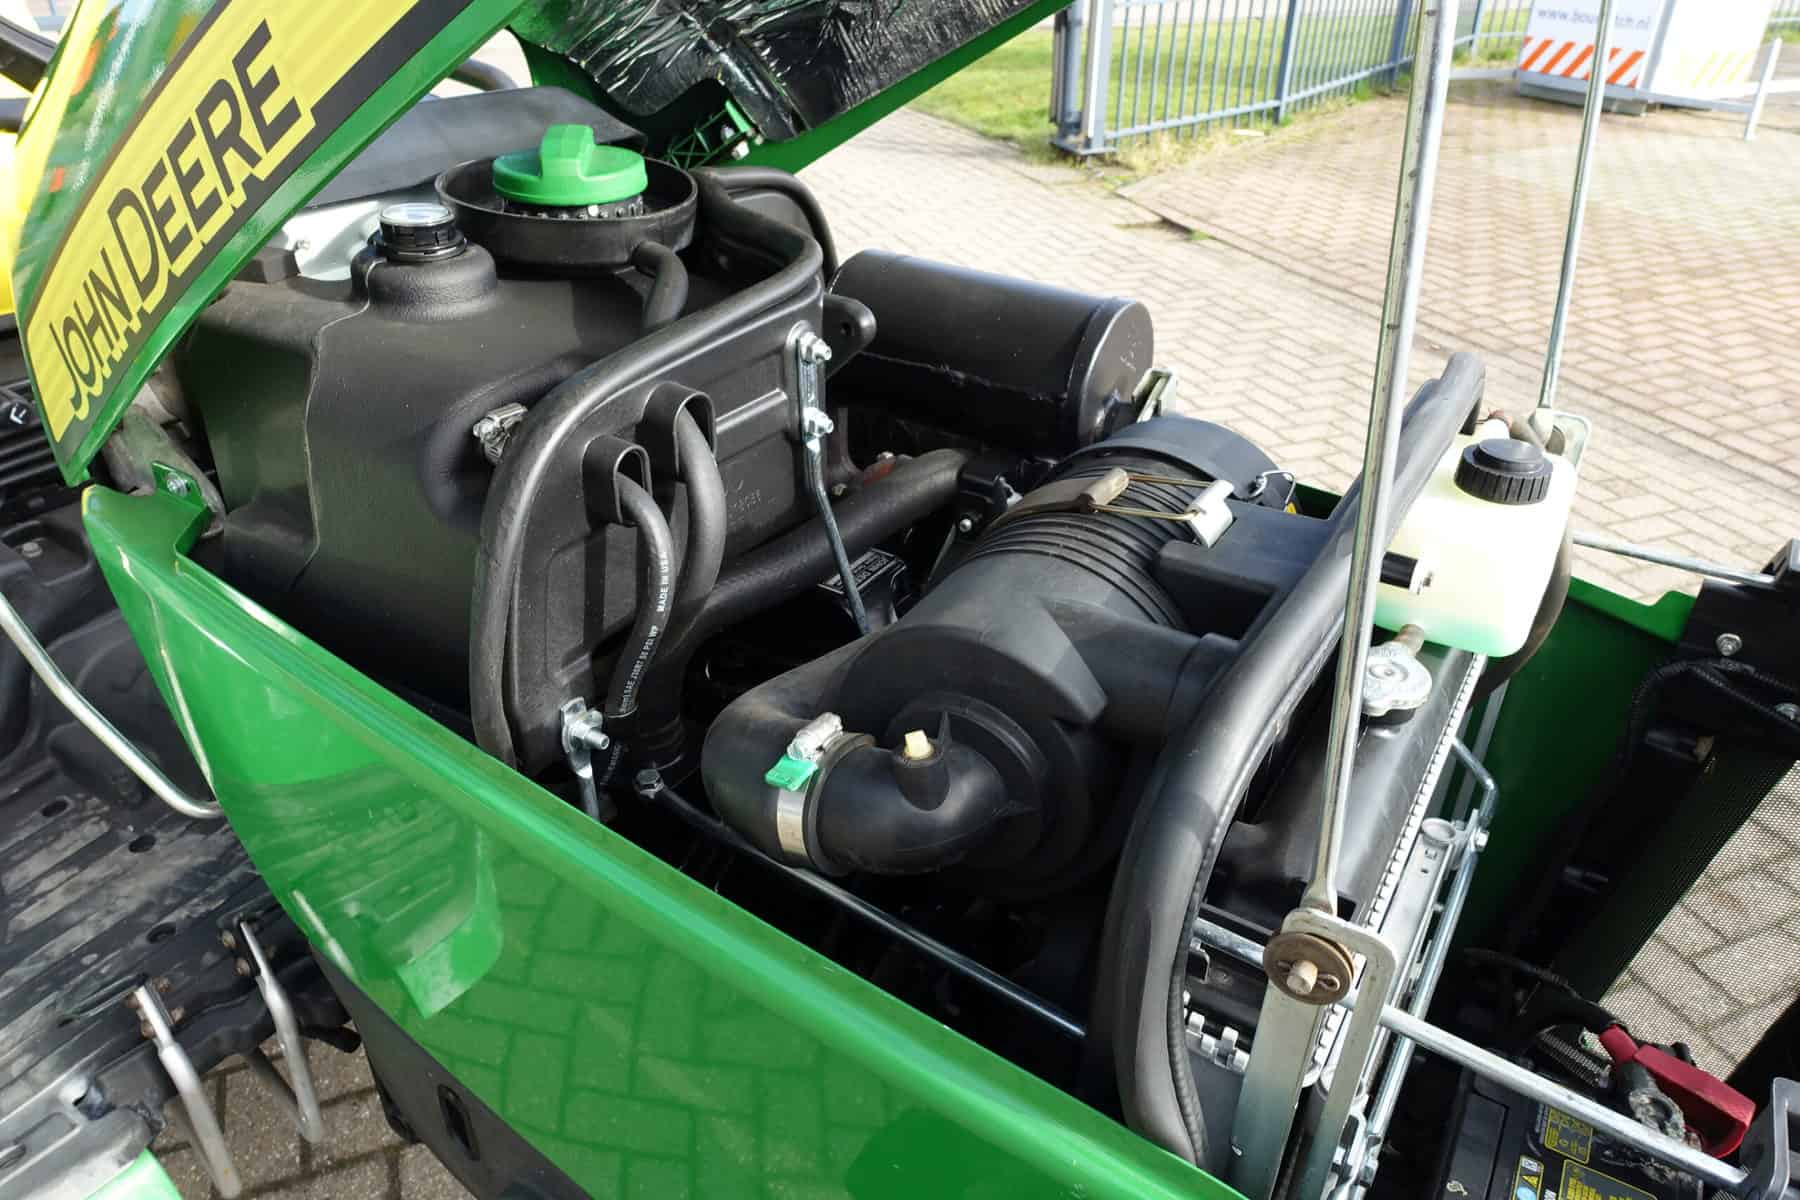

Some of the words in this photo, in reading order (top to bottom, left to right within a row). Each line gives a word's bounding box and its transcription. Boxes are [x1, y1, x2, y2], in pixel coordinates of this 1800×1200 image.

[1538, 9, 1649, 30] www.boutch.nl
[49, 248, 135, 407] JOHN
[108, 18, 302, 303] DEERE
[655, 586, 669, 612] MADE
